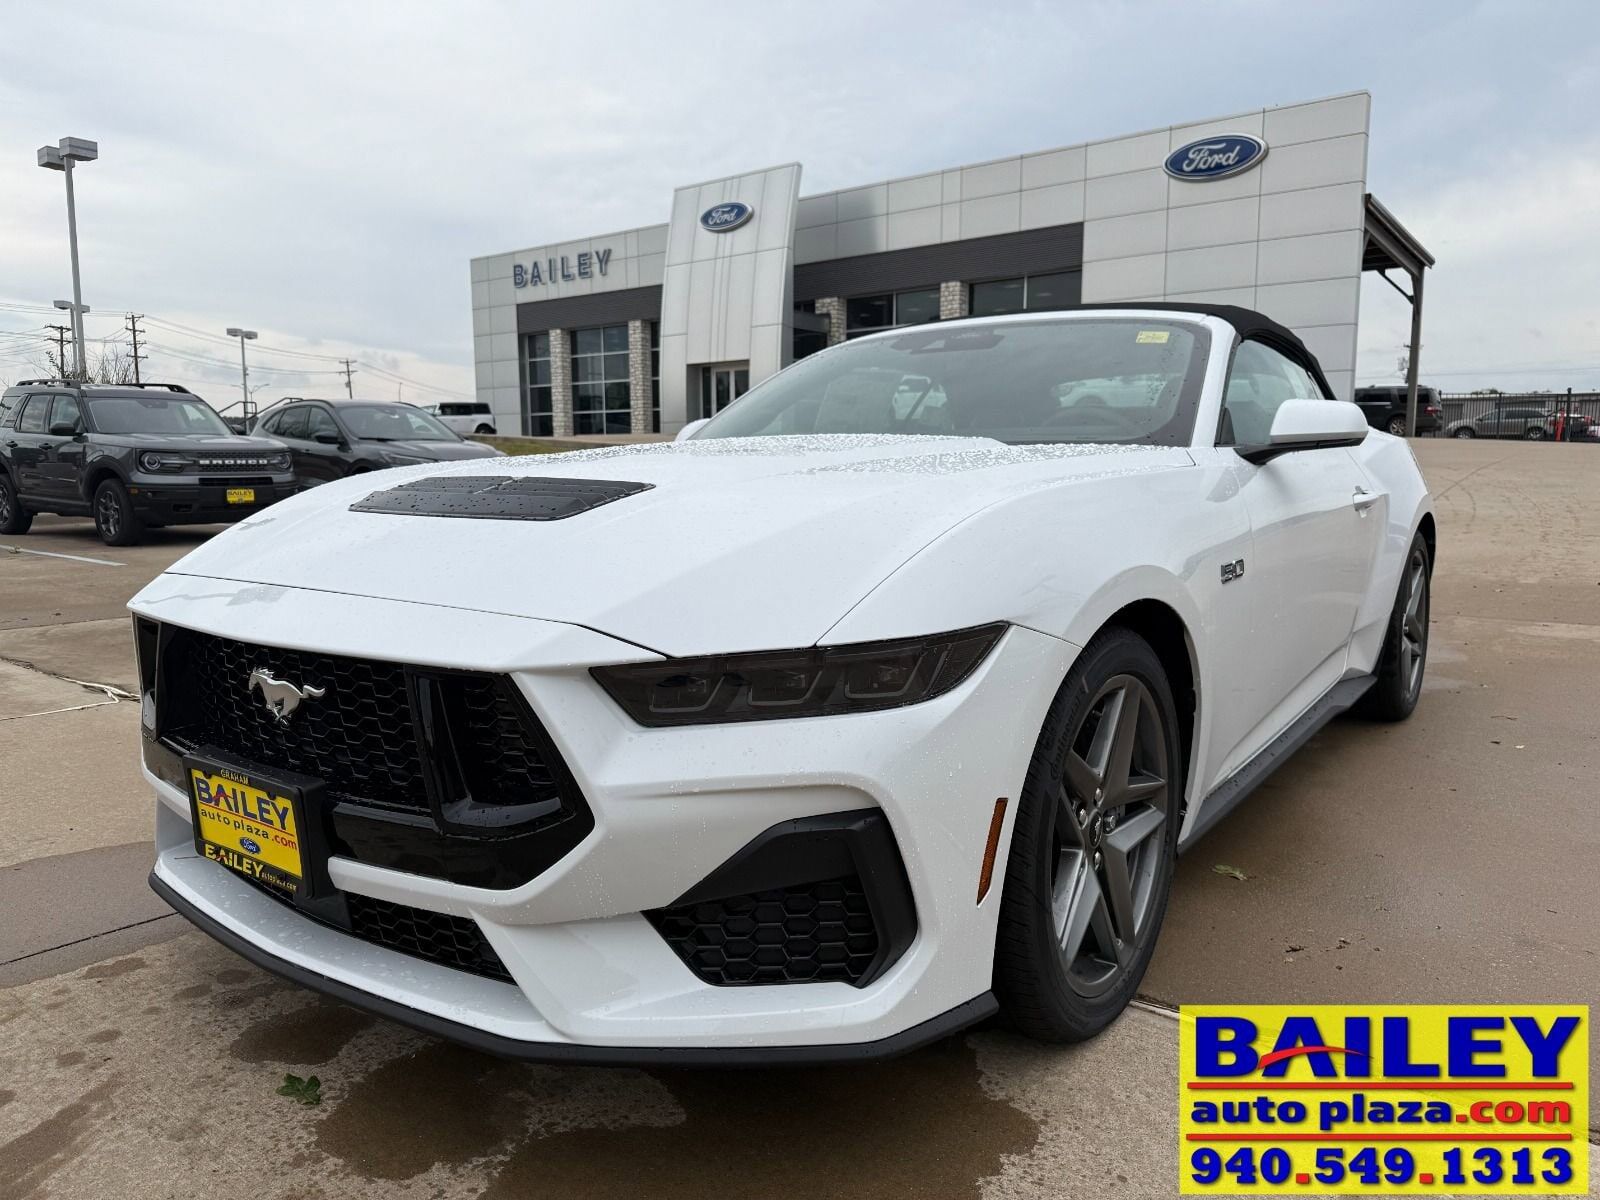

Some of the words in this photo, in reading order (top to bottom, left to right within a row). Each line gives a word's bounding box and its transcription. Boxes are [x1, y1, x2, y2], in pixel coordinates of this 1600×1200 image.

[1182, 142, 1241, 172] Ford
[708, 207, 736, 226] Ford
[513, 249, 612, 288] BAILEY
[220, 768, 249, 785] GRAHAM
[194, 777, 290, 831] BAILEY
[200, 807, 231, 826] auto
[205, 843, 264, 879] BAILEY
